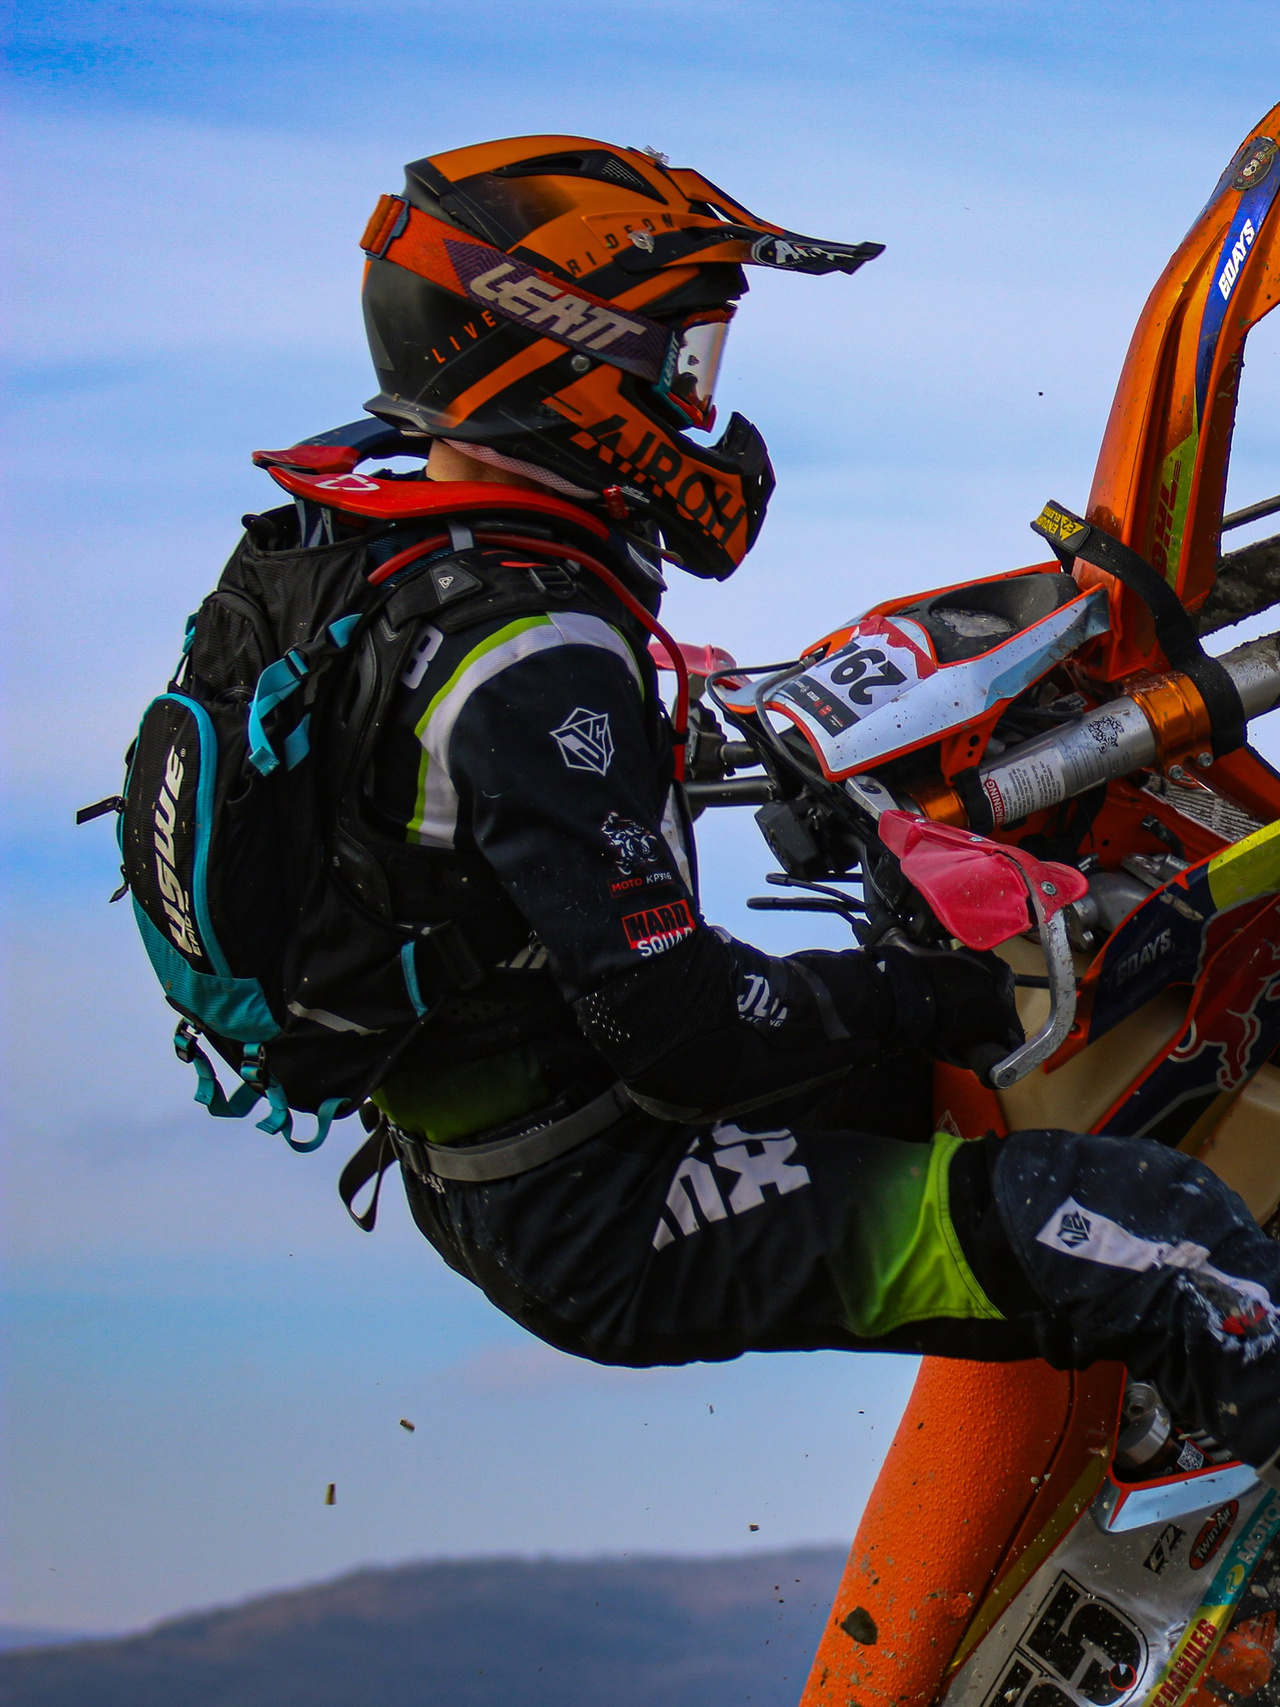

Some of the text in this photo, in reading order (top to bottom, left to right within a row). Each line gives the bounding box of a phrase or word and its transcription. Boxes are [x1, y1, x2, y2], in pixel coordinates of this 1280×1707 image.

[431, 309, 497, 364] LIVE
[469, 262, 648, 351] LEATT
[569, 414, 746, 550] AIROH
[153, 745, 194, 954] USWE
[624, 903, 691, 940] HARD
[1192, 1504, 1235, 1561] Twin Air
[1146, 1617, 1218, 1707] ЕПАНЦЕВ
